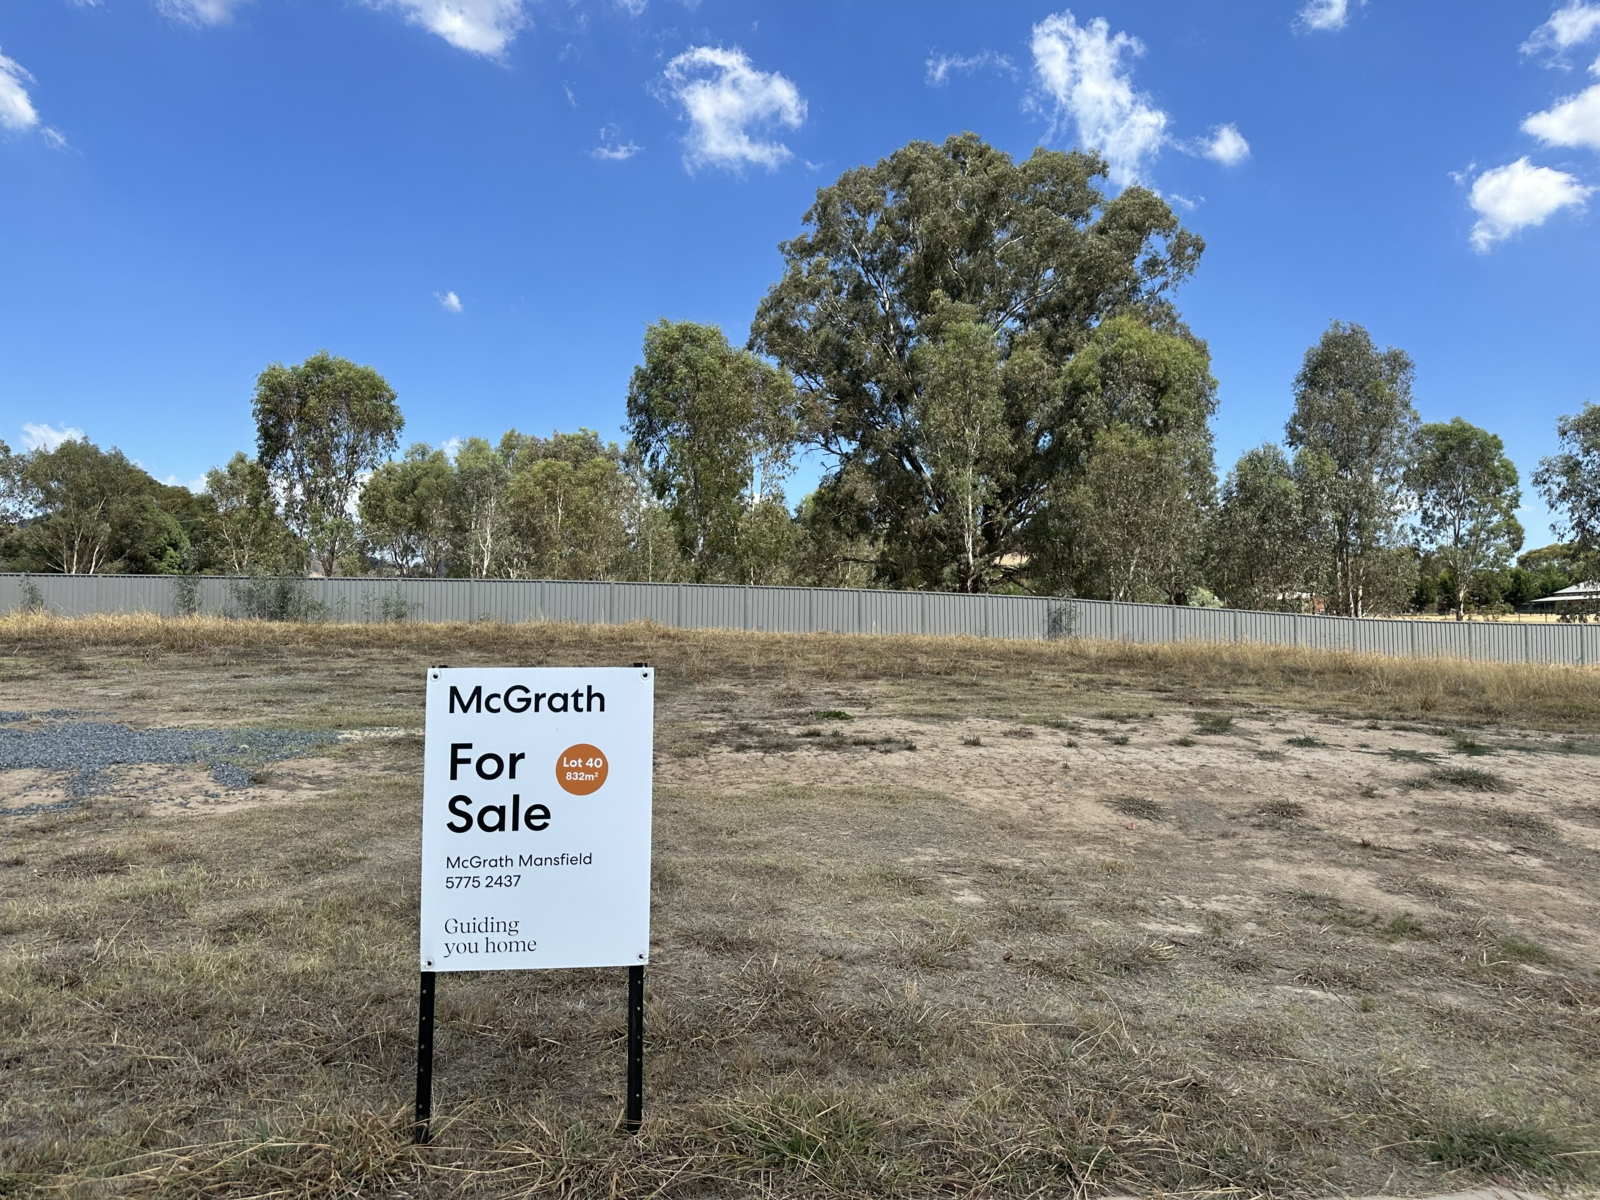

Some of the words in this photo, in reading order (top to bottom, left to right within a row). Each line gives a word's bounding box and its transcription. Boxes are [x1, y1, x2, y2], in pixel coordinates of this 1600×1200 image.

[448, 685, 606, 714] McGrath
[449, 743, 526, 781] For
[563, 757, 583, 768] Lot
[585, 757, 603, 768] 40
[447, 794, 552, 833] Sale
[446, 855, 514, 869] McGrath
[518, 852, 593, 867] Mansfield
[445, 876, 481, 889] 5775
[484, 875, 522, 888] 2437
[444, 917, 520, 937] Guiding
[443, 942, 479, 959] you
[485, 937, 537, 953] home
